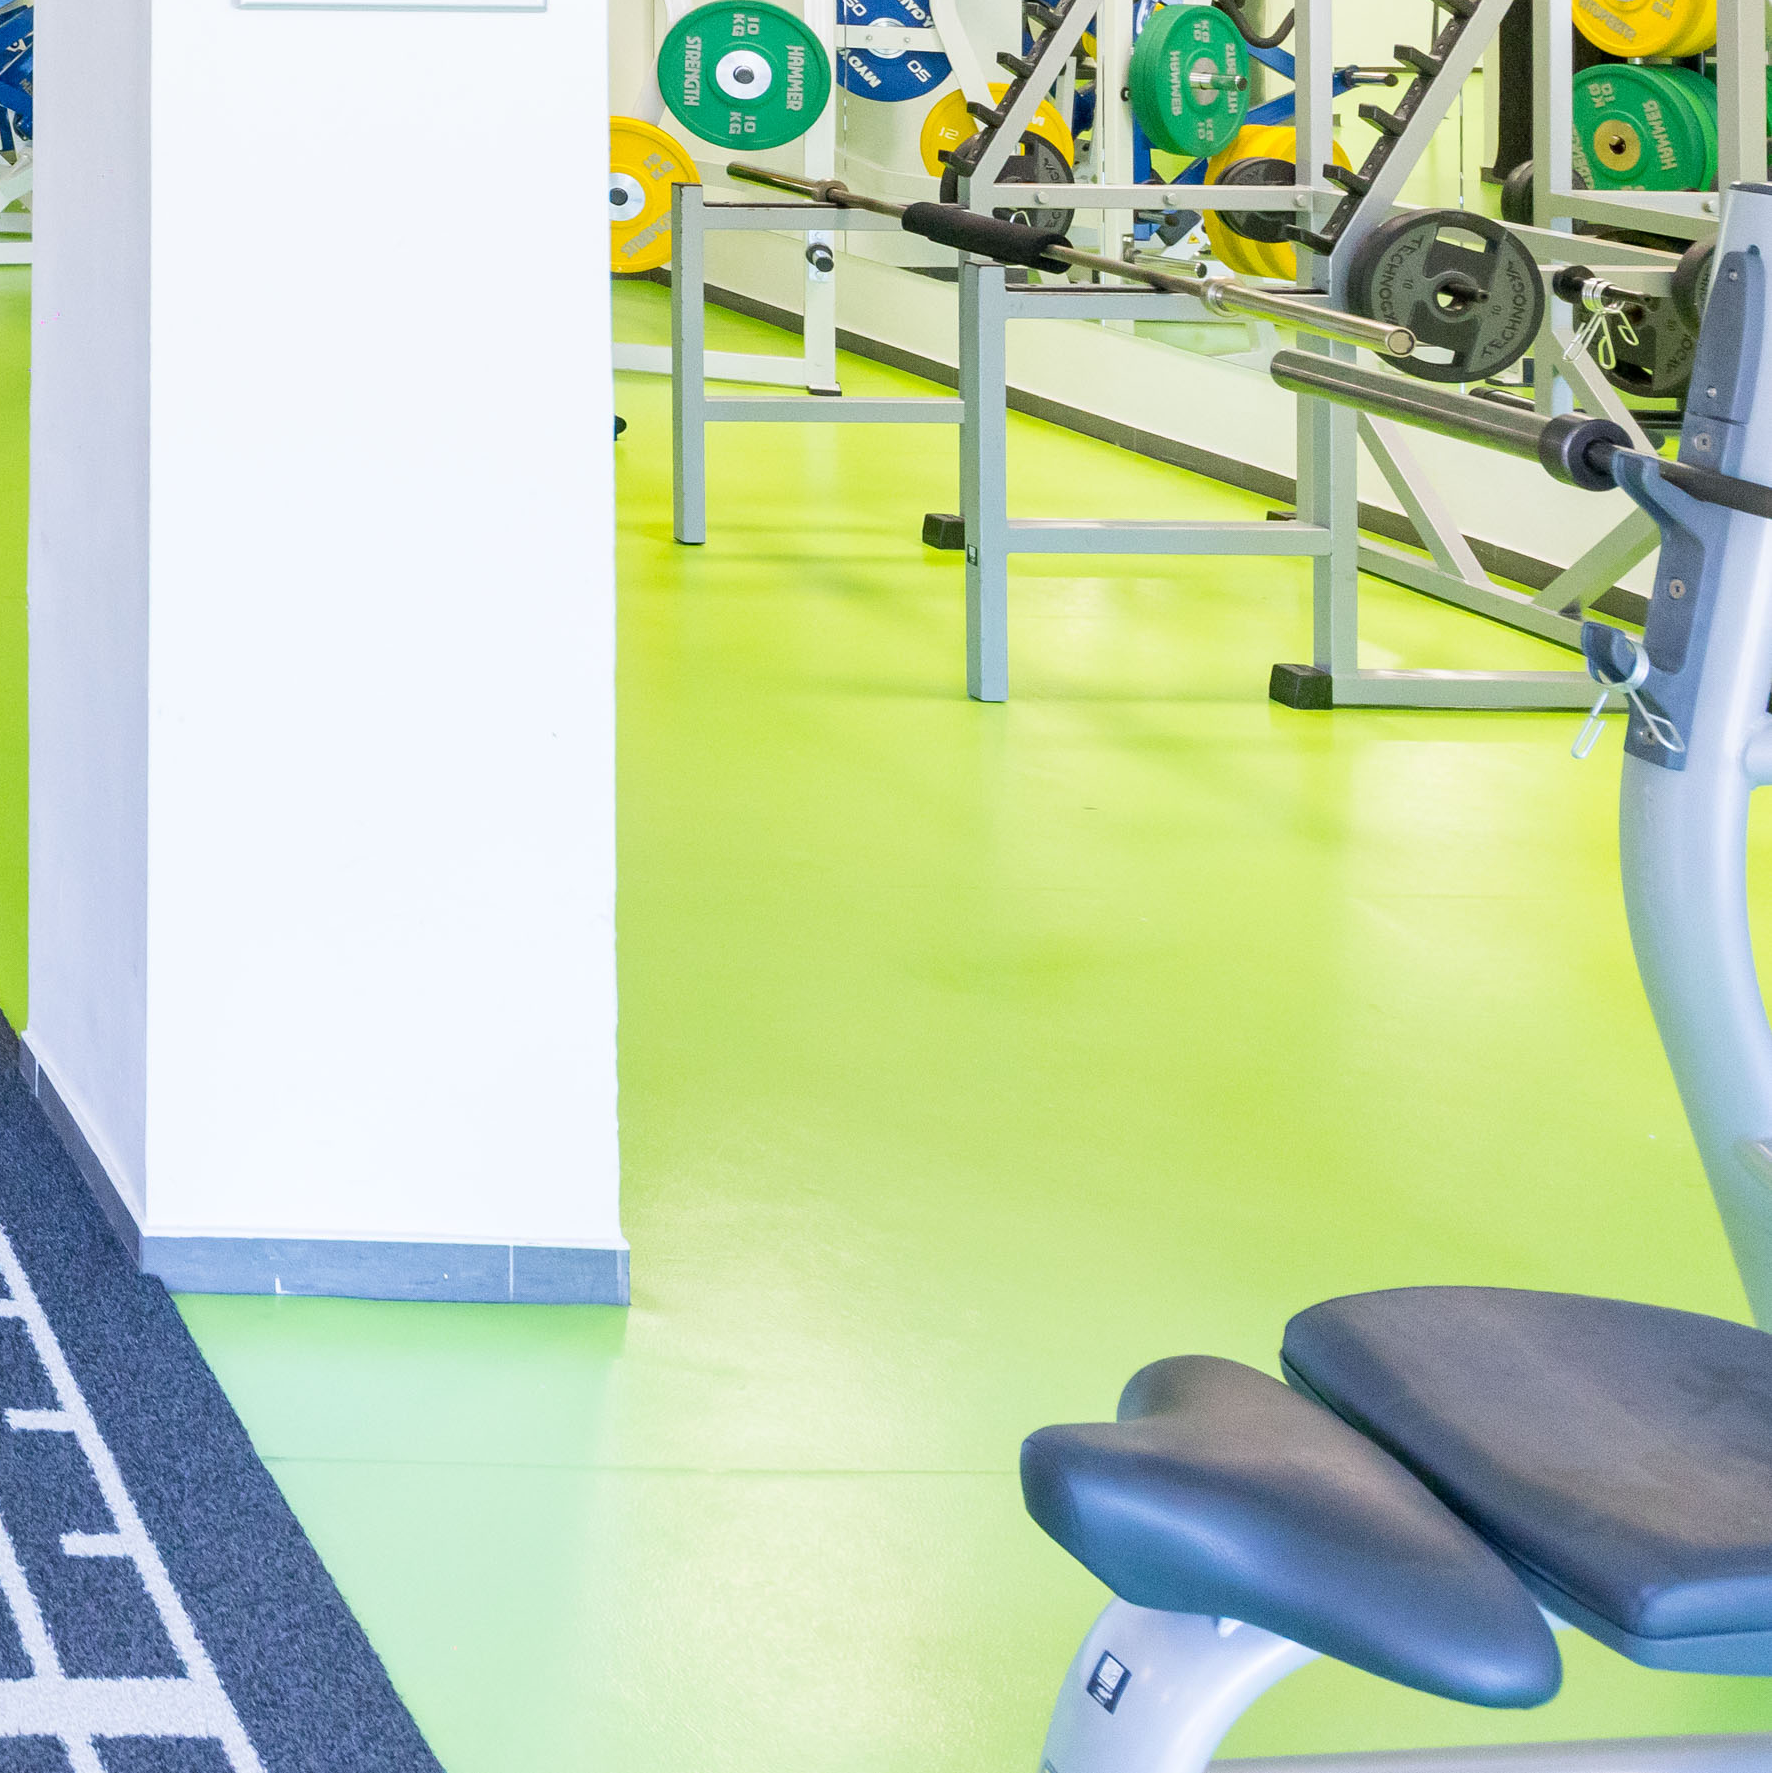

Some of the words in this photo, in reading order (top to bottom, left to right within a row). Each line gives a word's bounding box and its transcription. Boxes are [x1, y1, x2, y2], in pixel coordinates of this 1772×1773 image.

[731, 13, 746, 37] KG
[747, 16, 760, 36] 10
[683, 35, 703, 107] STRENGTH
[785, 44, 805, 112] HAMMER
[729, 111, 742, 135] KG
[743, 115, 757, 134] 10
[1481, 261, 1528, 357] TECHNOGYM
